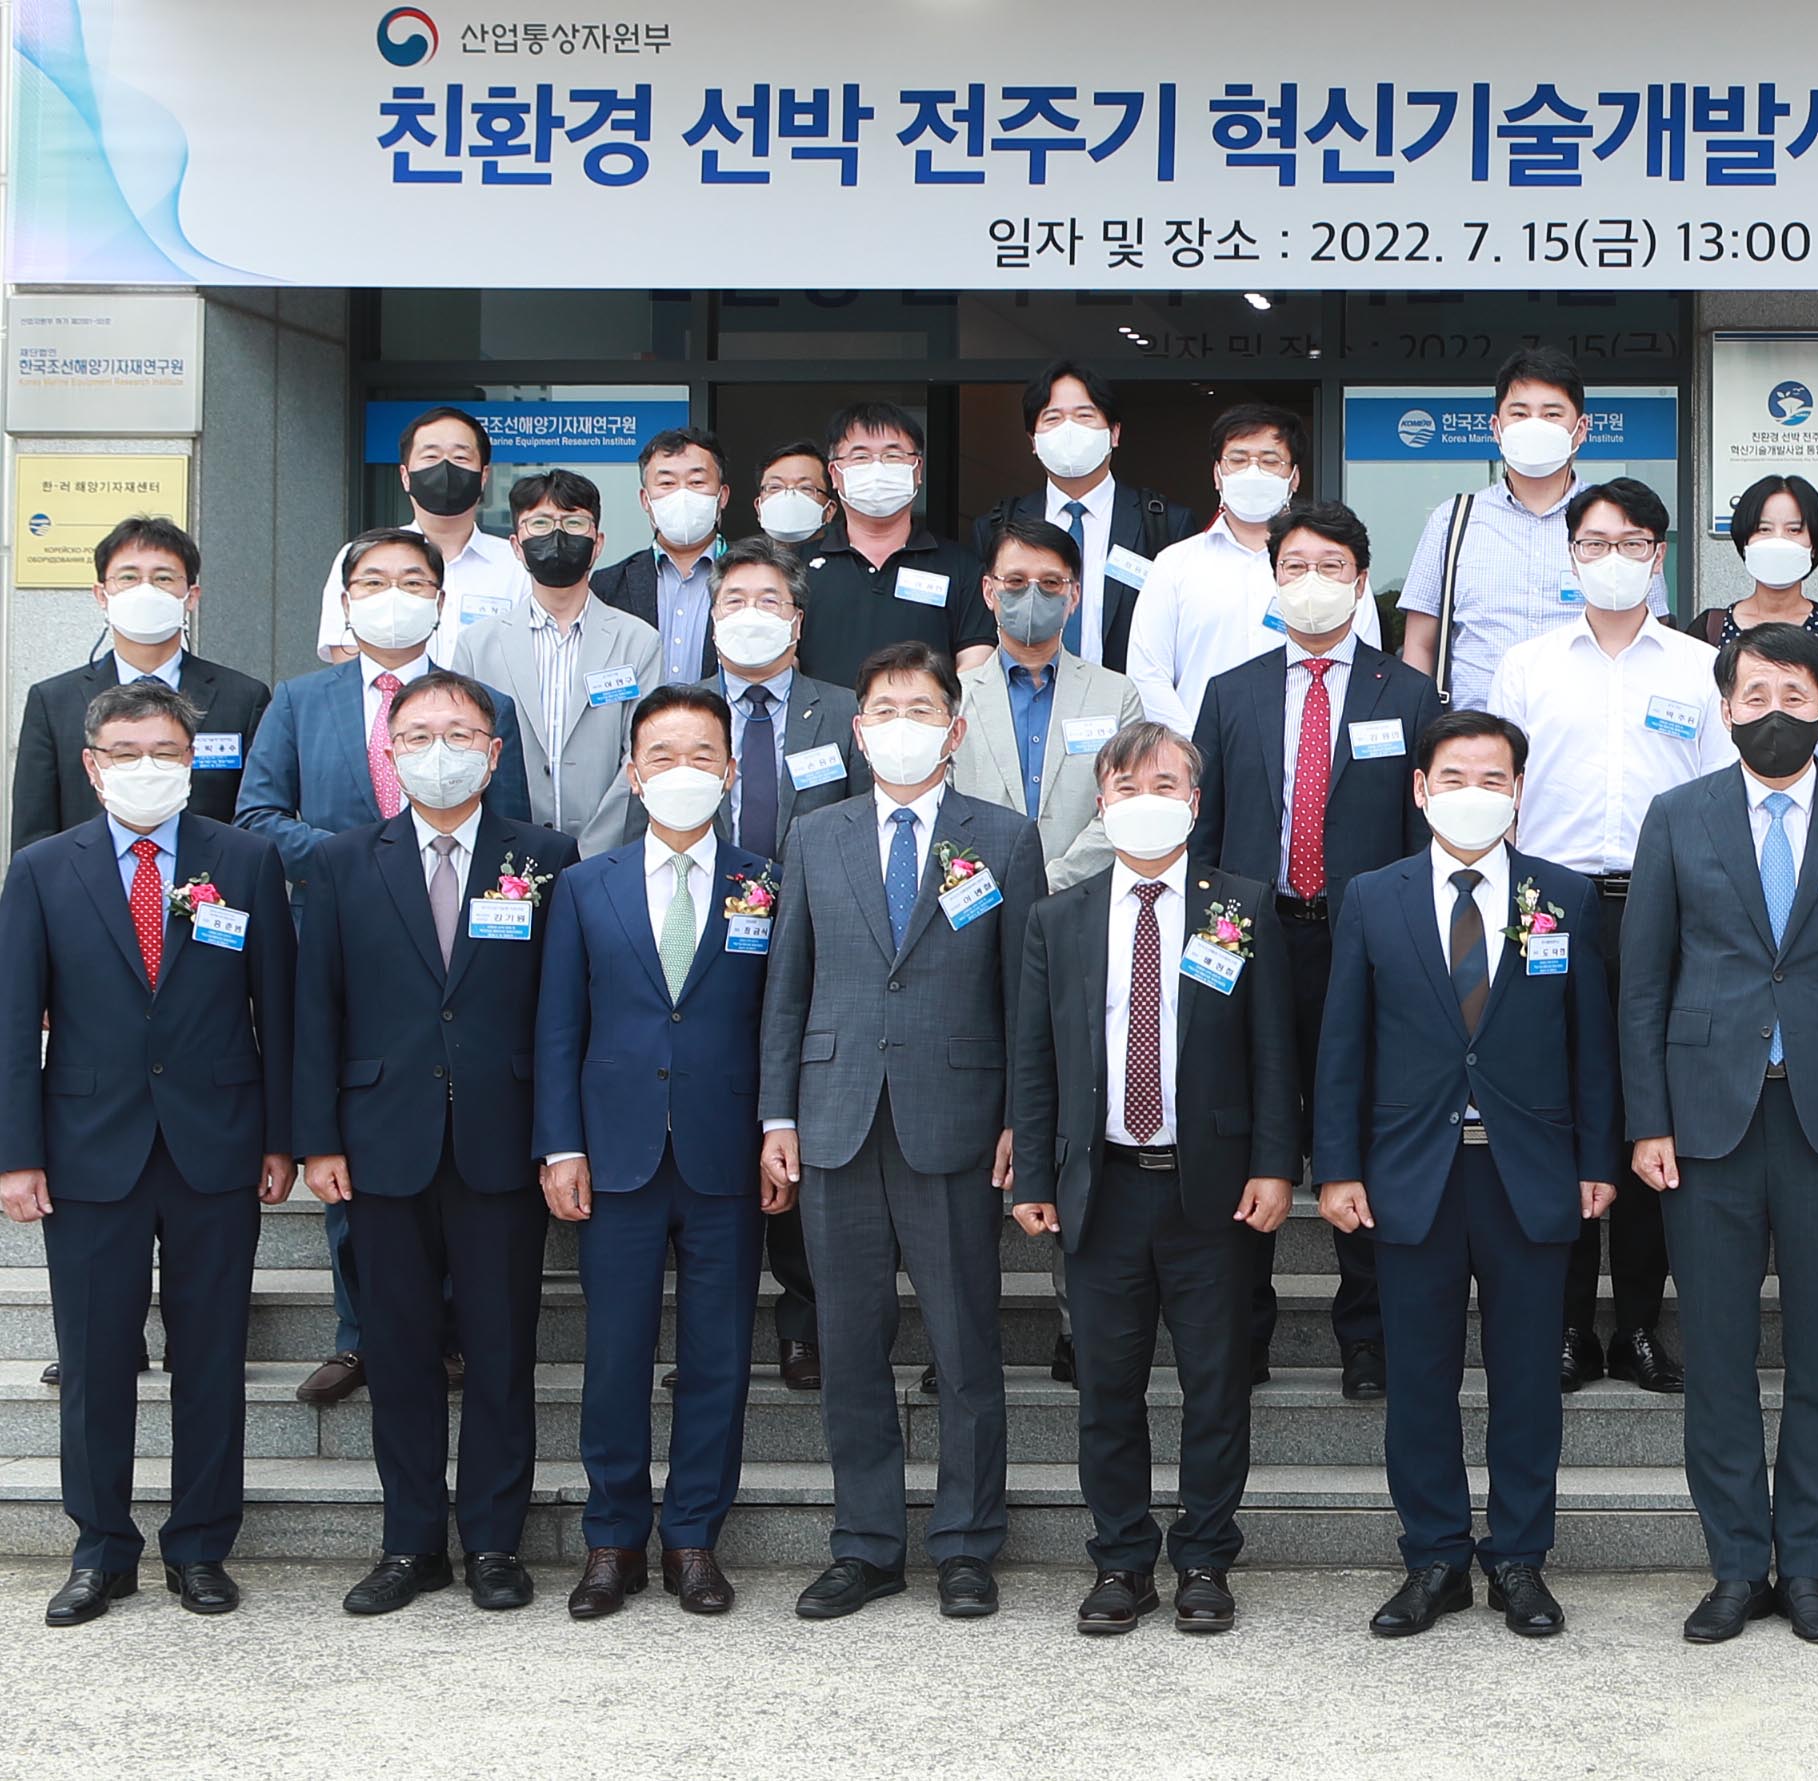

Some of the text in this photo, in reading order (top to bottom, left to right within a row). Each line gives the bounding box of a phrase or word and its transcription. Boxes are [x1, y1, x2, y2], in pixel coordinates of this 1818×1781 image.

[459, 22, 673, 57] 산업통상자원부
[376, 83, 652, 187] 친환경
[681, 82, 875, 187] 선박
[895, 82, 1177, 186] 전주기
[988, 217, 1084, 268] 일자
[1102, 217, 1144, 269] 및
[1164, 217, 1260, 269] 장소
[1280, 230, 1290, 260] :
[1310, 221, 1443, 263] 2022.
[1463, 222, 1501, 263] 7.
[1522, 218, 1657, 268] 15(금)
[1676, 221, 1811, 262] 13:00
[19, 359, 184, 376] 한국조선해양기자재연구원
[475, 416, 637, 435] 국조선해양기자재연구원
[515, 437, 560, 448] Equipment
[561, 437, 600, 446] Research
[602, 437, 637, 446] Institute
[1441, 434, 1467, 443] Korea
[1588, 434, 1624, 443] Institute
[1751, 431, 1779, 443] 친환경
[1781, 431, 1800, 443] 선박
[1730, 444, 1804, 457] 혁신기술개발사업
[75, 481, 160, 494] 해양기자재센터
